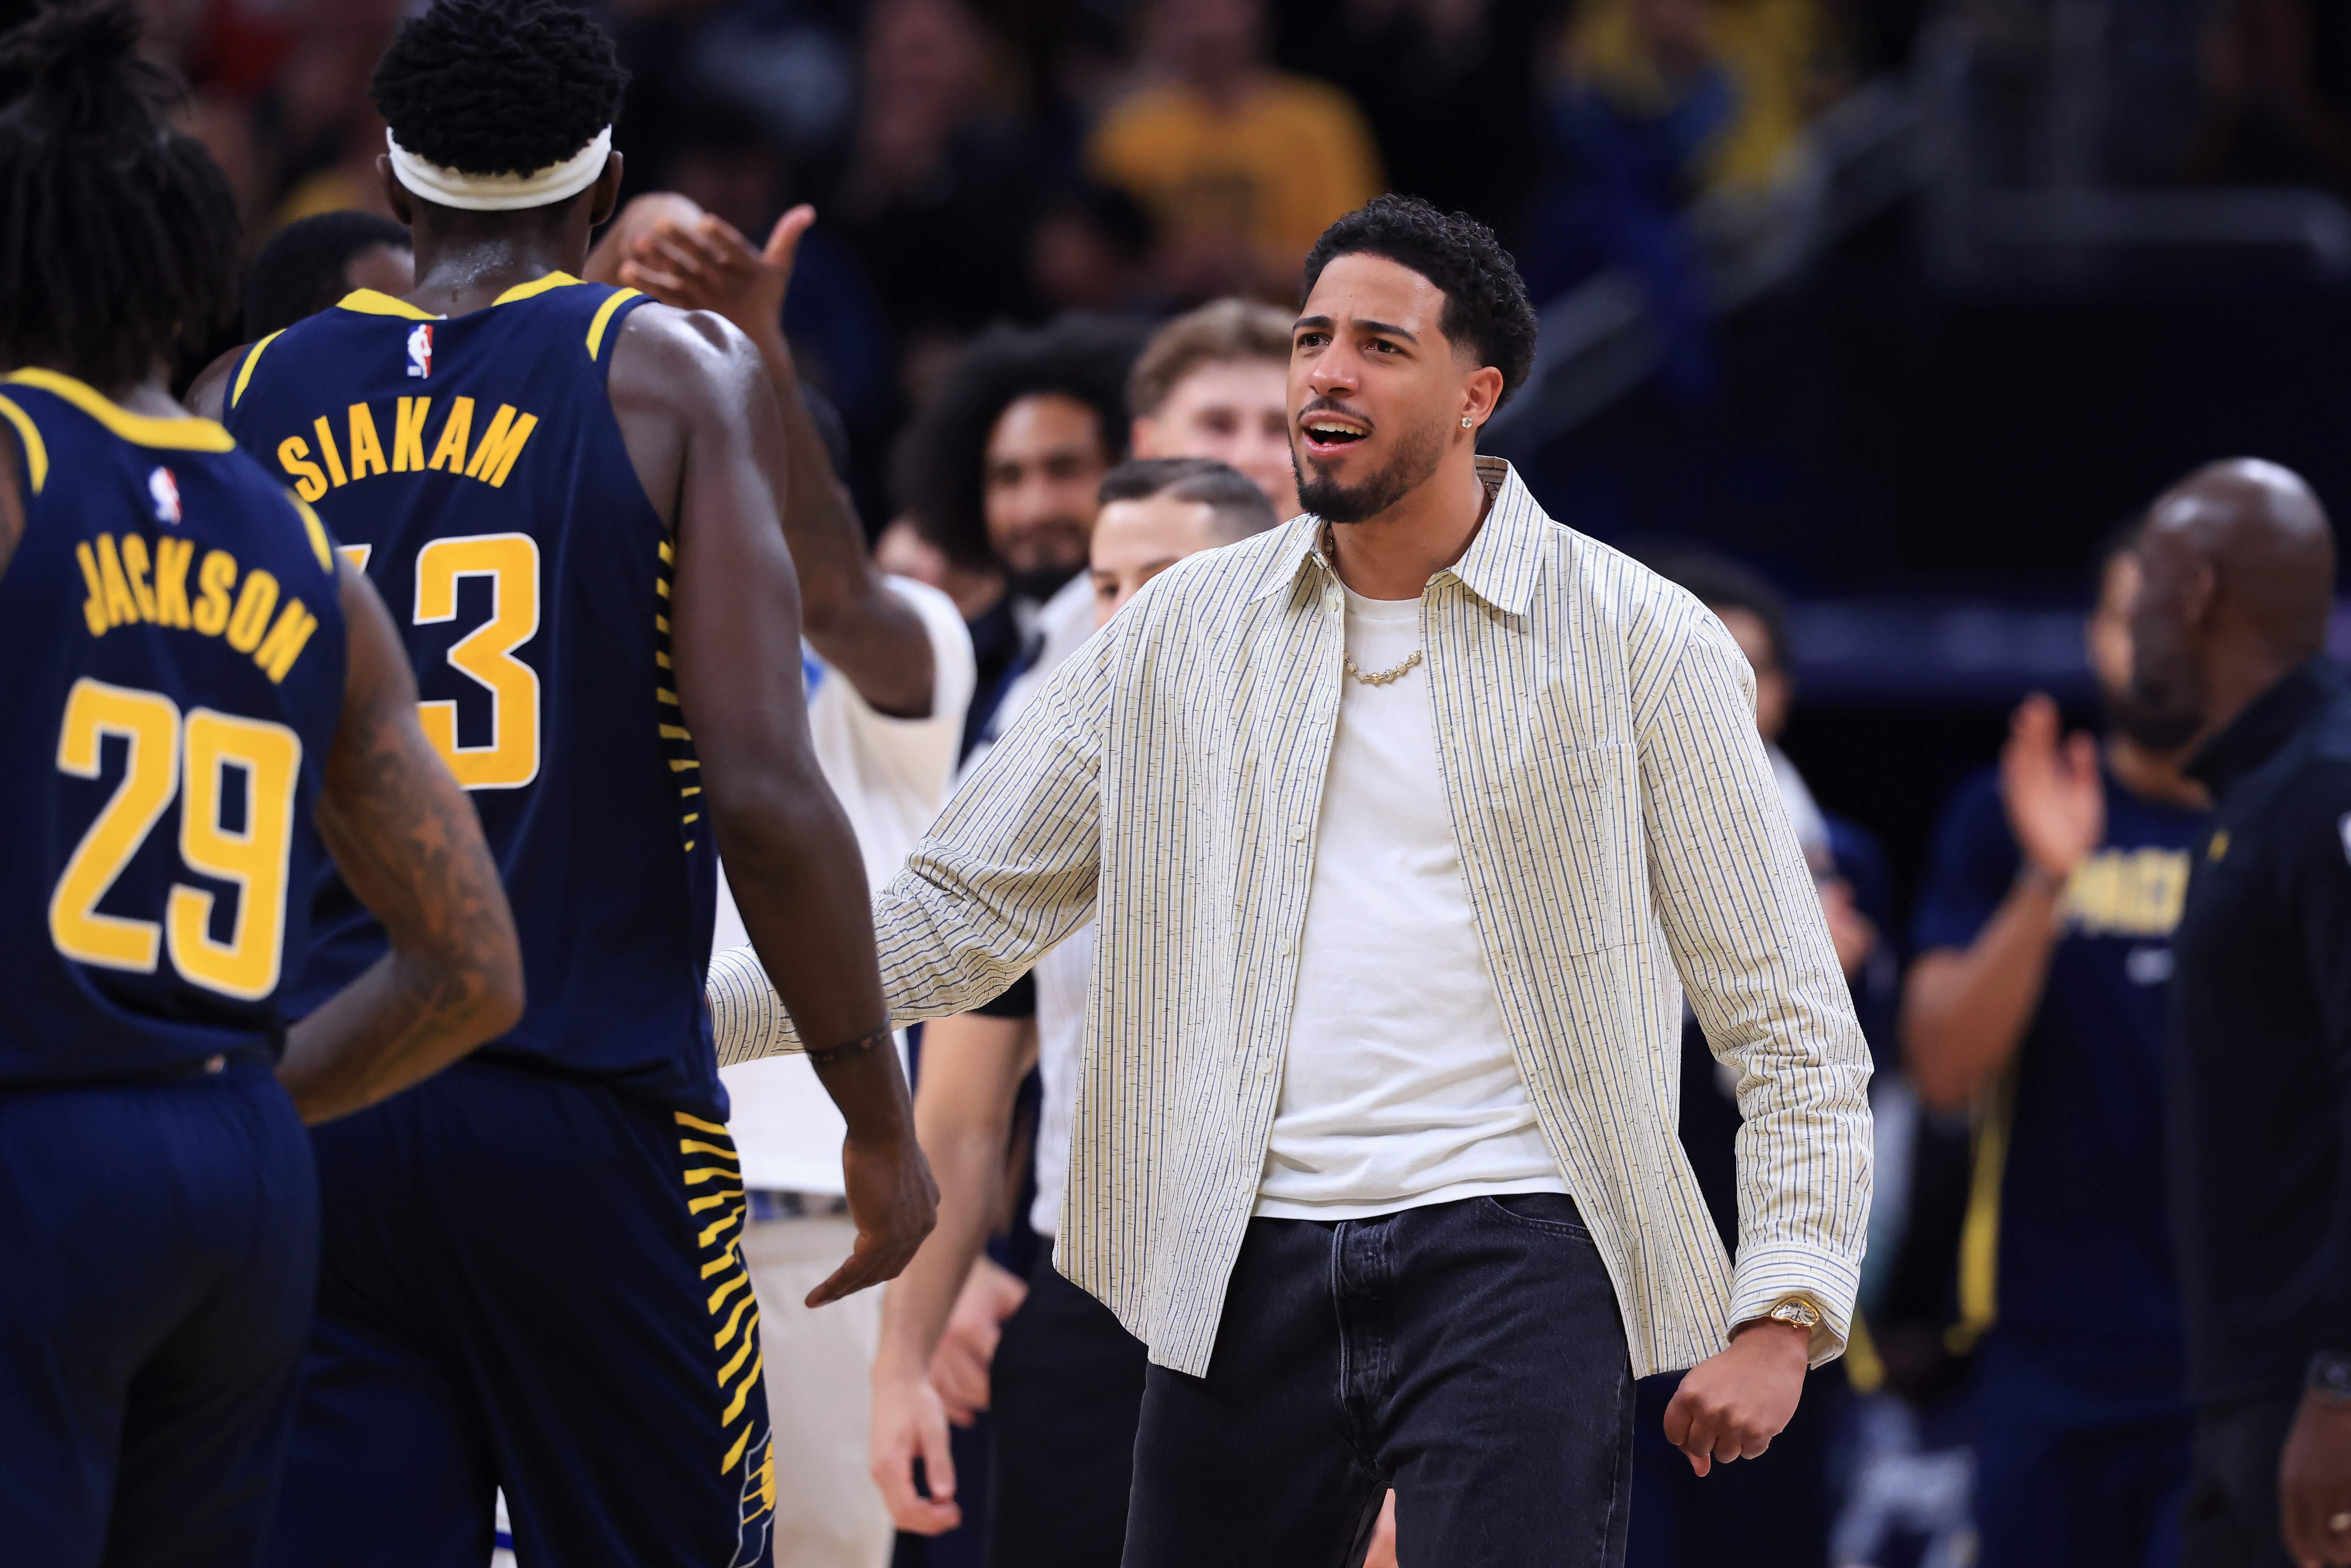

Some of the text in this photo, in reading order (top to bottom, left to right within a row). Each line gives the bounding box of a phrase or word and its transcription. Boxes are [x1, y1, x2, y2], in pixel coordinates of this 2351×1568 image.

[277, 396, 538, 502] SIAKAM
[76, 532, 317, 683] JACKSON
[336, 531, 540, 790] 3
[49, 677, 302, 1000] 29
